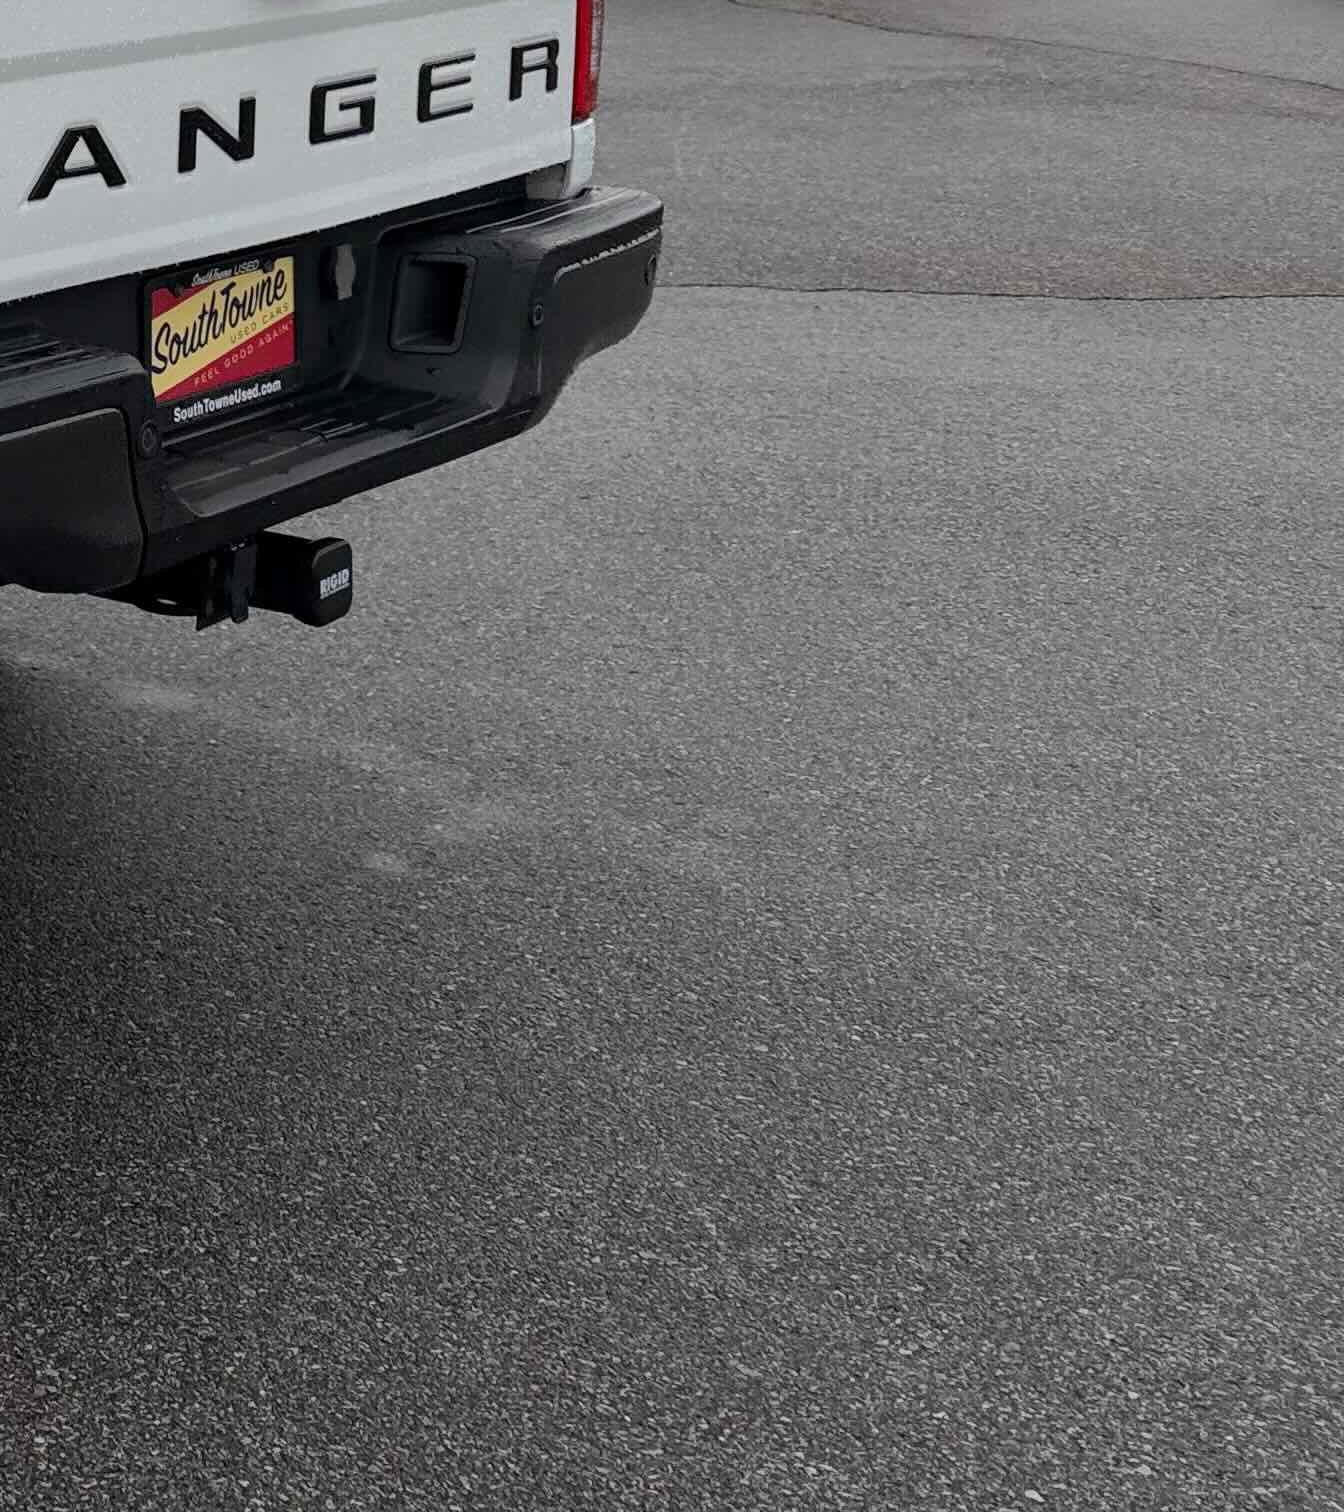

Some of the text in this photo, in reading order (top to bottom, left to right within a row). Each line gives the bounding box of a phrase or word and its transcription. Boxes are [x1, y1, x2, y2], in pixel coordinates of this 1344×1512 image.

[223, 344, 254, 368] GOOD
[173, 379, 282, 423] SouthTowneUsed.com
[319, 568, 350, 595] RIGID
